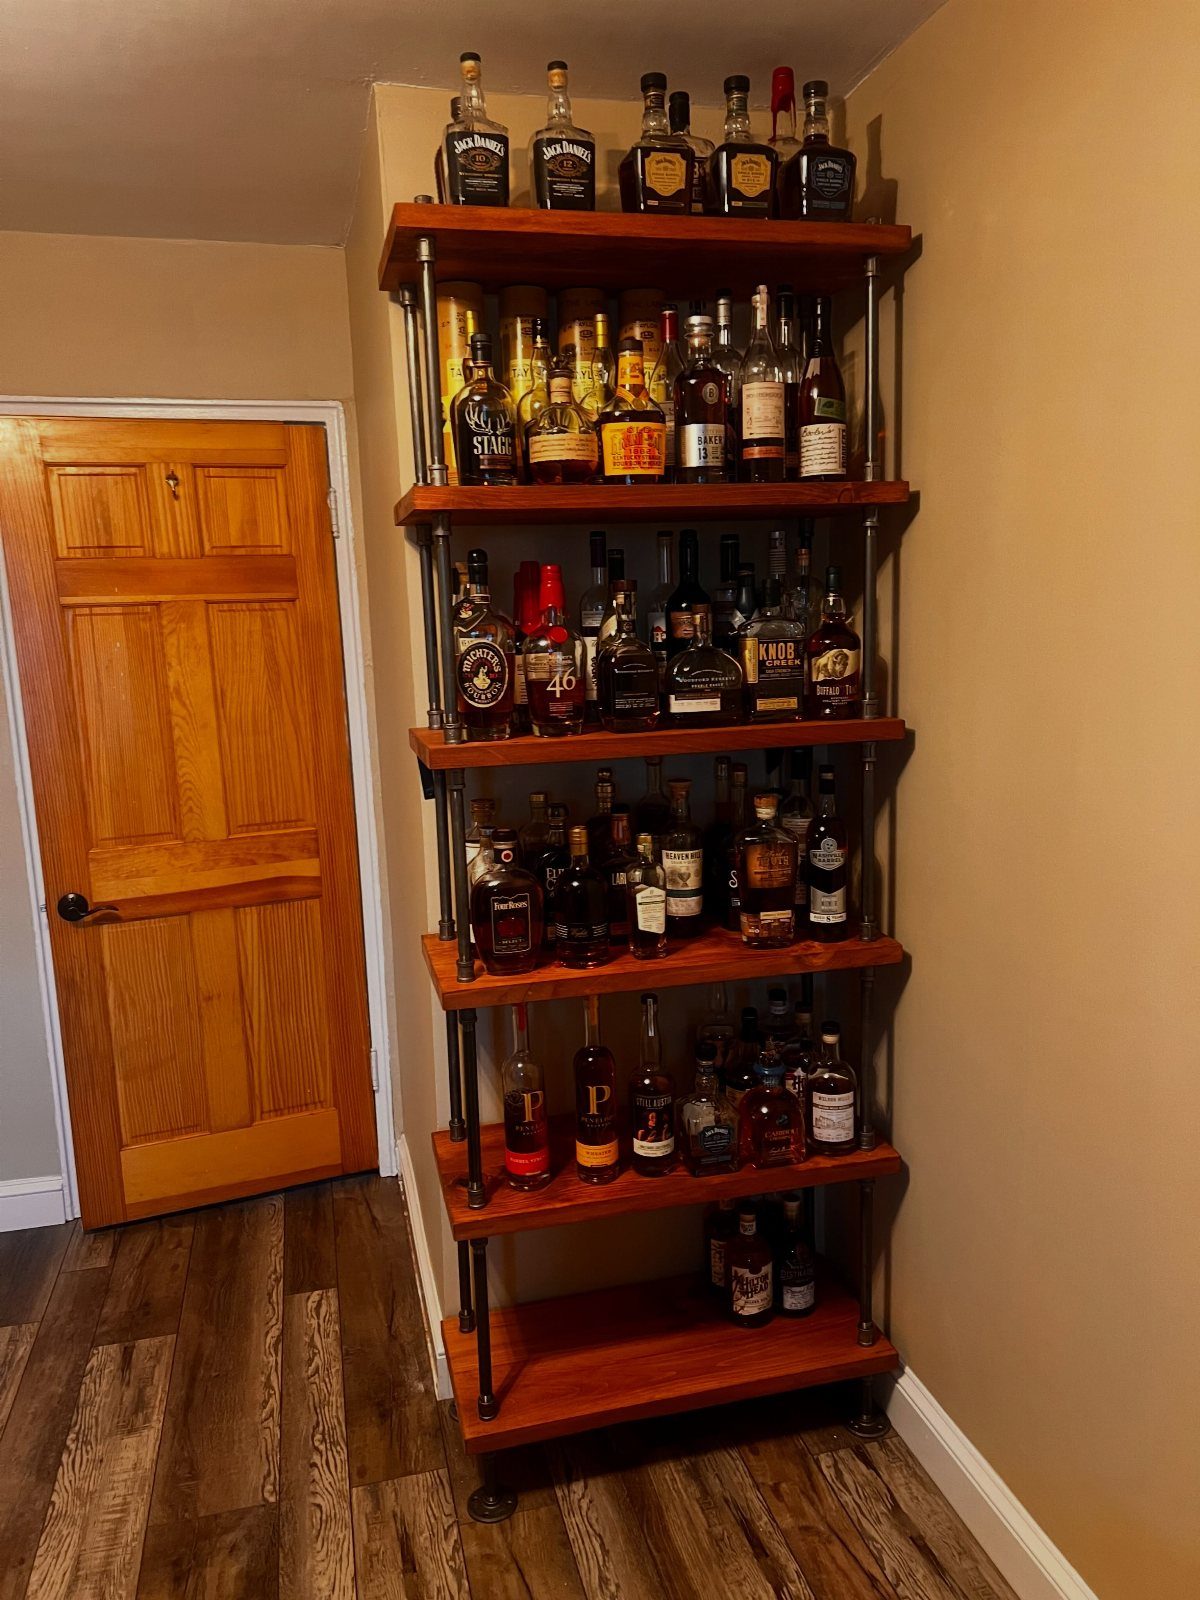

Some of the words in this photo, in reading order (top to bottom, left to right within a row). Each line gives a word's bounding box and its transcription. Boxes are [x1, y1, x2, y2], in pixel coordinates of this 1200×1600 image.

[454, 137, 475, 154] JACK
[473, 133, 506, 157] DANIEL'S
[542, 143, 563, 160] JACK
[561, 140, 591, 164] DANIEL'S
[475, 154, 486, 162] 10
[562, 160, 573, 168] 12
[473, 435, 513, 460] STAGG
[698, 447, 708, 460] 13
[462, 648, 502, 673] MICHTER'S
[759, 642, 795, 661] KNOB
[766, 659, 801, 667] CREEK
[463, 682, 502, 700] BOURBON
[546, 666, 577, 698] 46
[816, 684, 840, 696] BUFFALO
[665, 852, 690, 861] HEAVEN
[585, 1085, 611, 1115] P
